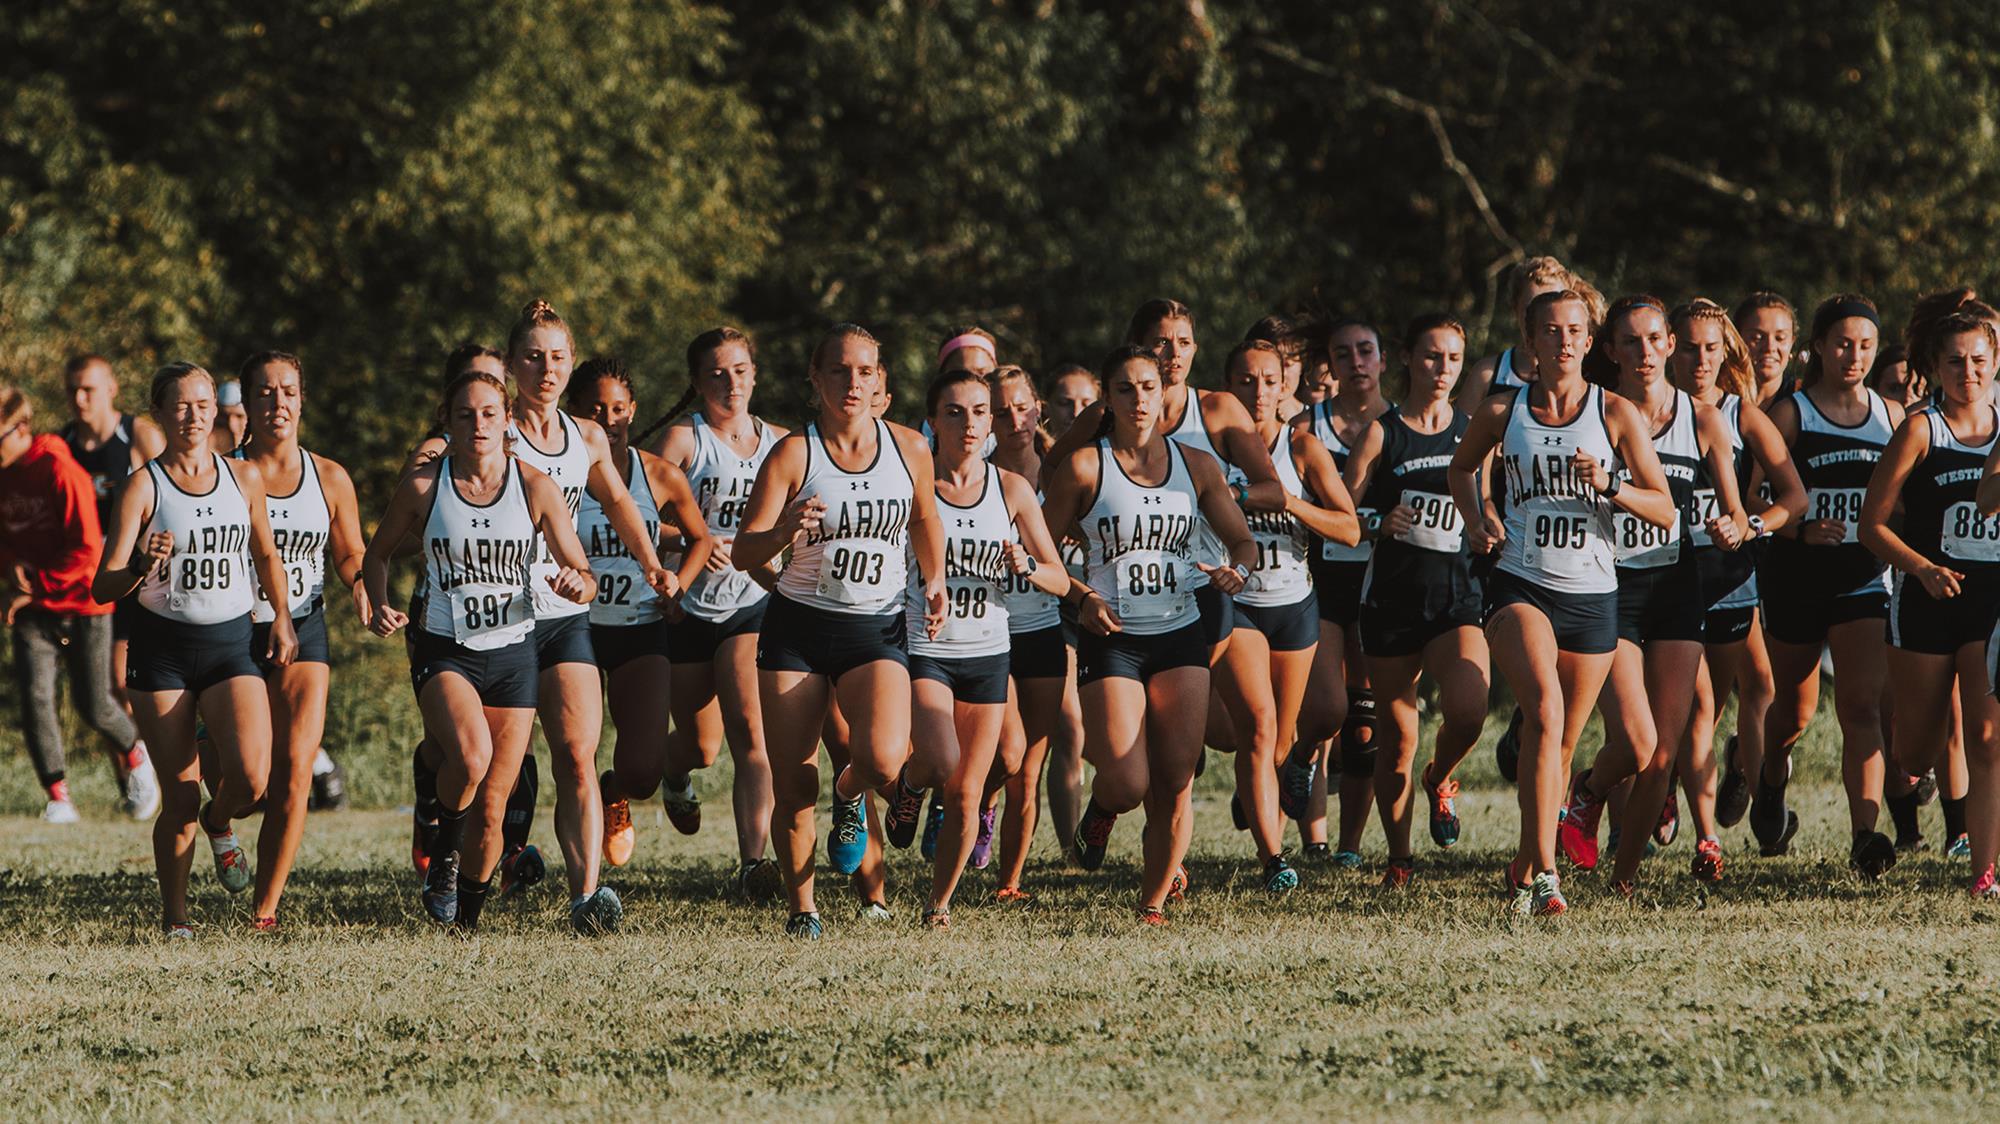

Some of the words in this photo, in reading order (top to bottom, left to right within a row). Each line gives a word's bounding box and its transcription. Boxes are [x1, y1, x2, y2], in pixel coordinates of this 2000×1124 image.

[1808, 449, 1882, 469] WESTMINST
[1410, 495, 1456, 532] 890
[1689, 494, 1717, 526] 87
[1815, 492, 1862, 525] 889
[1097, 514, 1198, 565] CLARION
[1535, 515, 1588, 549] 905
[182, 558, 231, 591] 899
[431, 537, 531, 593] CLARION
[831, 547, 884, 585] 903
[1128, 562, 1177, 597] 894
[597, 573, 632, 606] 92
[948, 586, 988, 620] 98
[463, 592, 513, 631] 897
